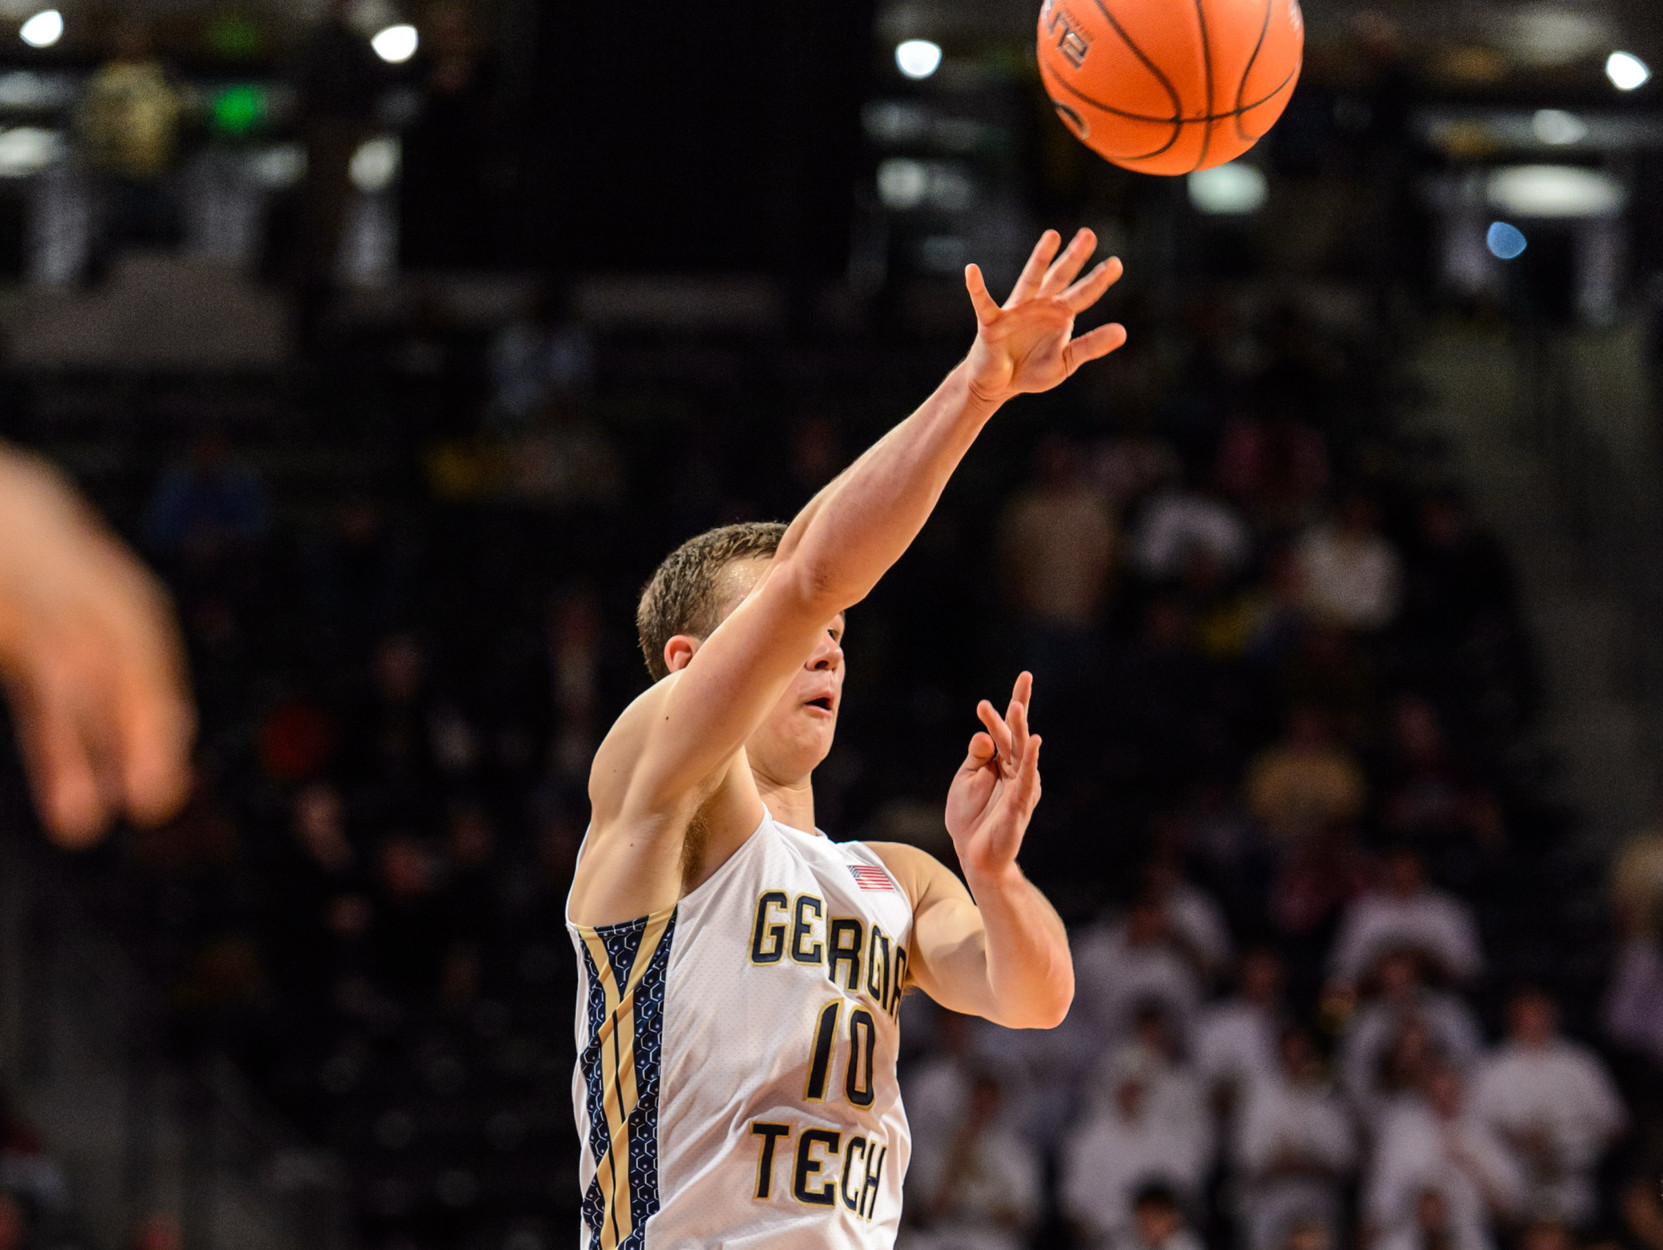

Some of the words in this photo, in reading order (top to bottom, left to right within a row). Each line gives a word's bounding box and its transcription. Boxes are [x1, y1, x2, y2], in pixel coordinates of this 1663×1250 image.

[750, 890, 907, 1024] GERGIA
[804, 998, 876, 1109] 10
[750, 1121, 887, 1221] TECH
